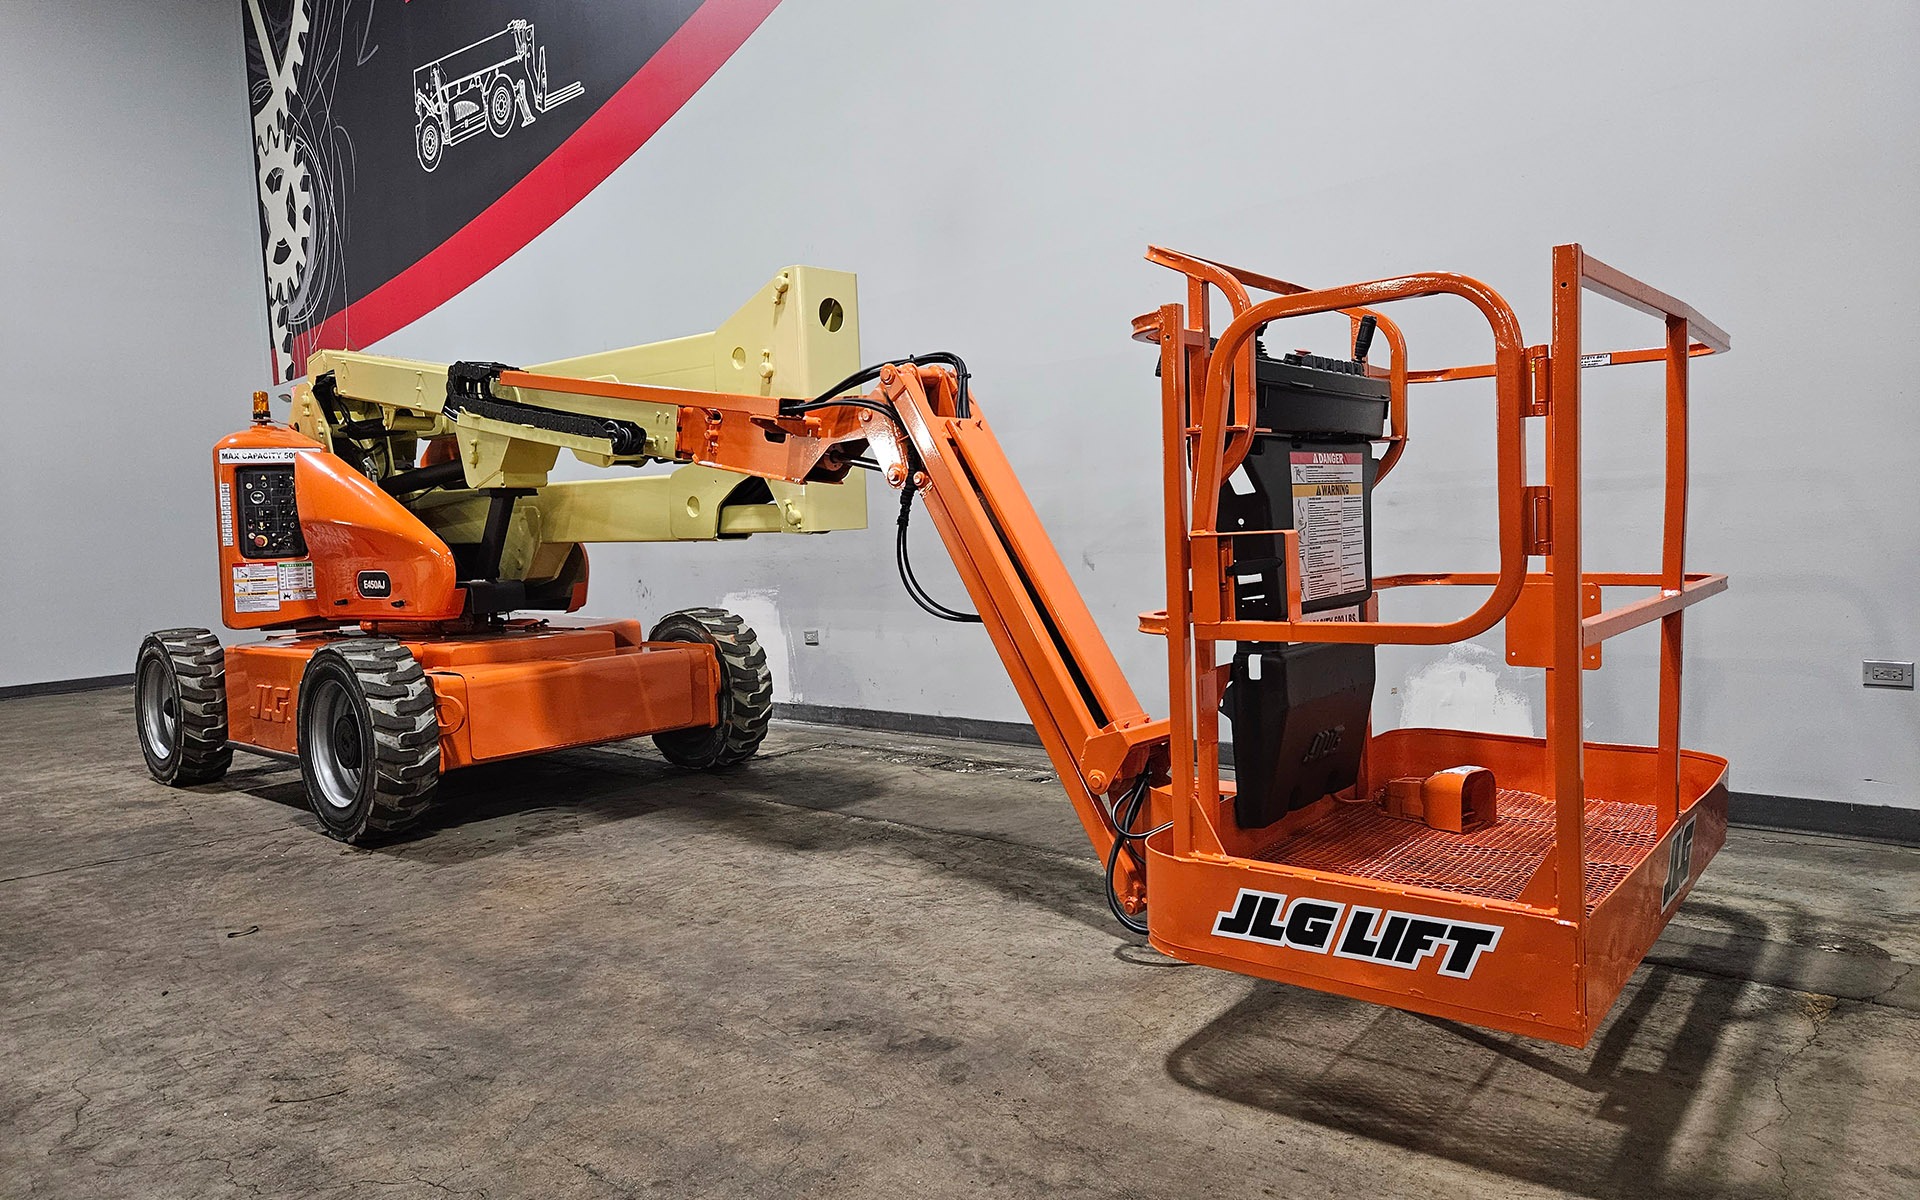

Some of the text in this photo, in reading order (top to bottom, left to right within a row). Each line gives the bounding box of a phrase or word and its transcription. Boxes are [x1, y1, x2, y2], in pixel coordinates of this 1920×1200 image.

[241, 452, 282, 460] CAPACITY
[1318, 453, 1344, 464] DANGER
[1322, 485, 1350, 496] WARNING
[363, 579, 386, 590] E450AJ
[249, 684, 291, 724] JLG
[1662, 818, 1696, 908] JLG
[1216, 892, 1497, 975] JLG LIFT
